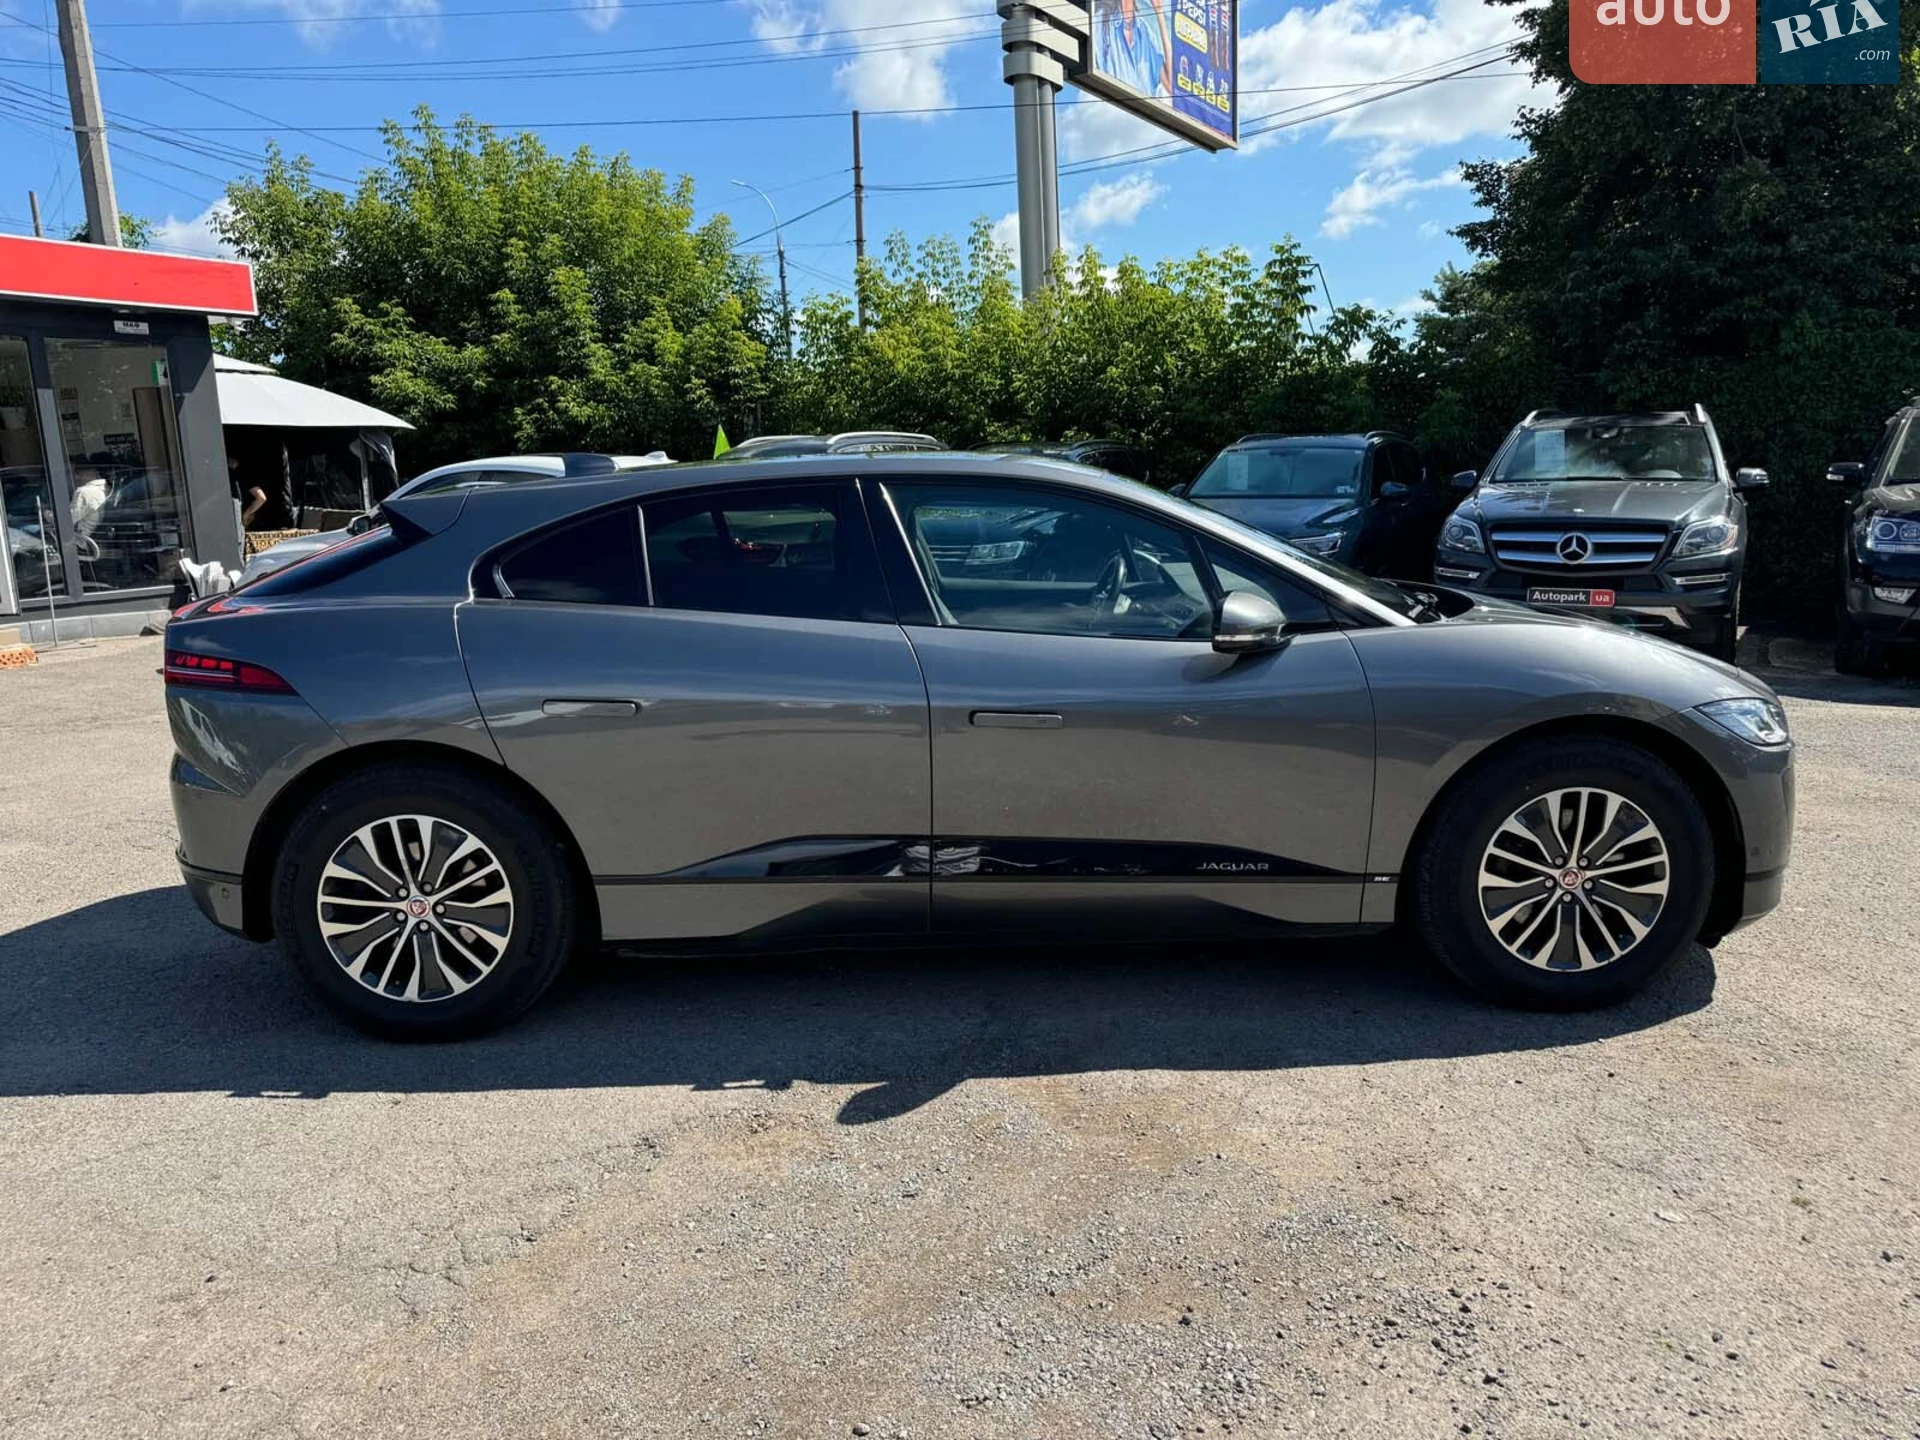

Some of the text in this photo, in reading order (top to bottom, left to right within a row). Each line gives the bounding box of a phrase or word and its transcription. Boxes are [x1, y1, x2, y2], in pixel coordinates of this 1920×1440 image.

[1182, 0, 1206, 27] PEPSI
[1532, 591, 1610, 603] Autopark ua
[1195, 862, 1269, 871] JAGUAR
